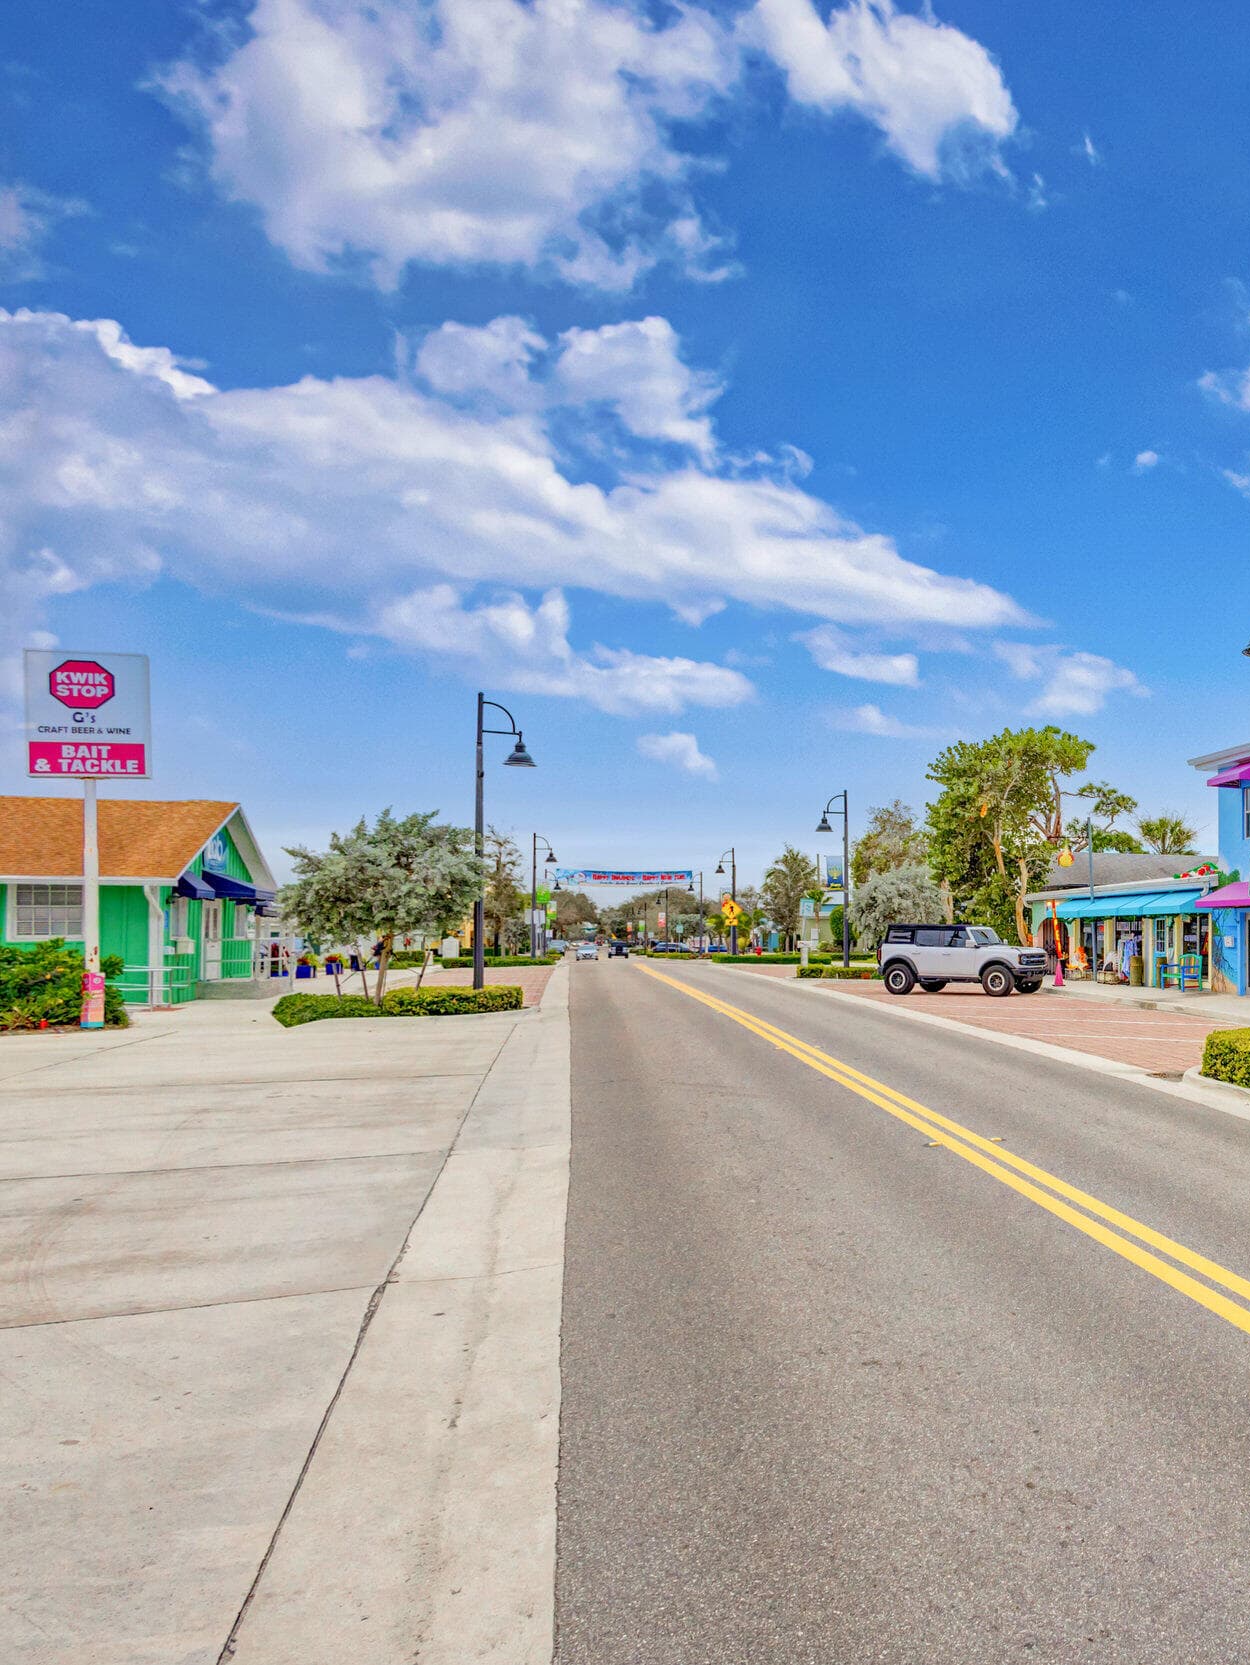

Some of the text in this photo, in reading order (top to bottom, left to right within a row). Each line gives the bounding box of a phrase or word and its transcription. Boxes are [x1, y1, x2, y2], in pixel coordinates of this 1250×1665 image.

[56, 672, 108, 685] KWIK
[56, 685, 109, 697] STOP
[73, 711, 96, 723] G's
[38, 725, 68, 734] CRAFT
[71, 726, 95, 735] BEER
[106, 727, 131, 736] WINE
[61, 745, 111, 759] BAIT
[34, 758, 139, 773] & TACKLE
